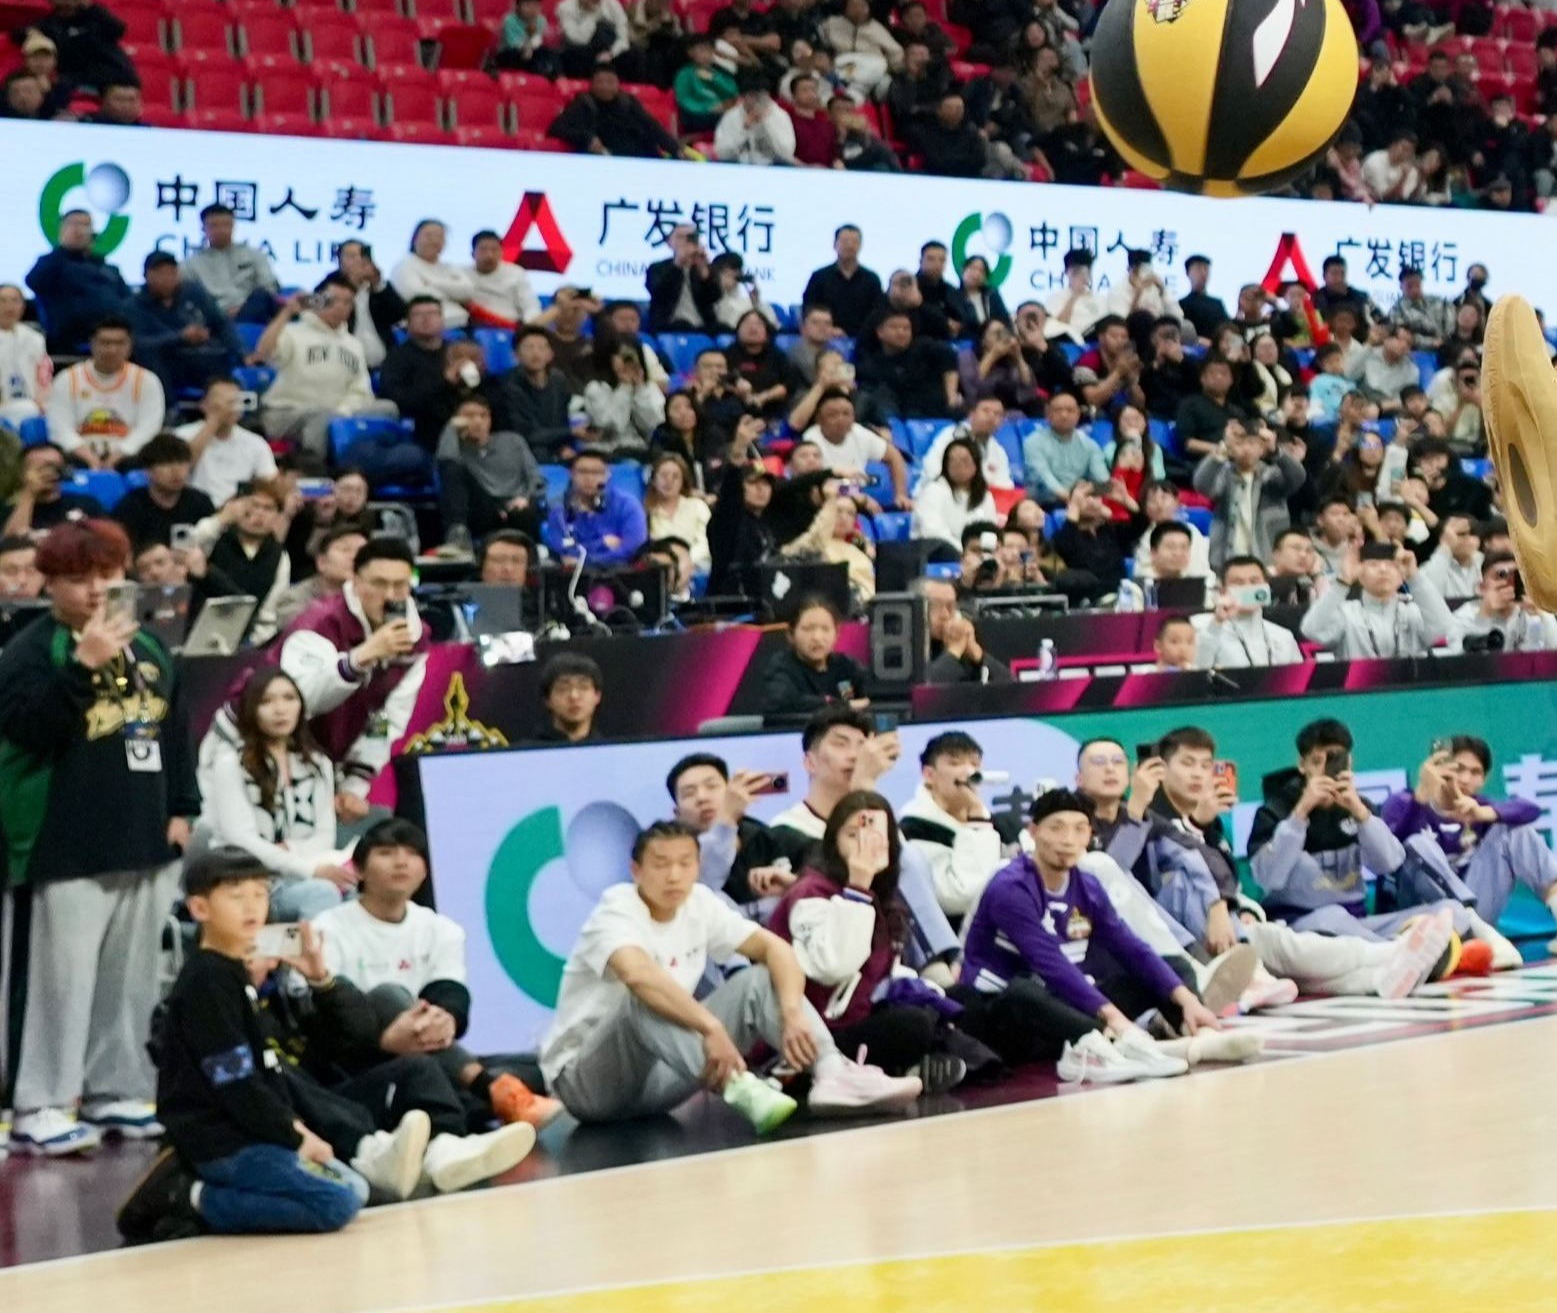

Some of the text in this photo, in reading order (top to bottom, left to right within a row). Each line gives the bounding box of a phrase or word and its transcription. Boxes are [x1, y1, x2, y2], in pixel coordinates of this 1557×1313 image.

[156, 173, 376, 231] 中国人寿
[599, 198, 775, 254] 广发银行
[1030, 220, 1179, 267] 中国人寿
[1336, 238, 1458, 283] 广发银行
